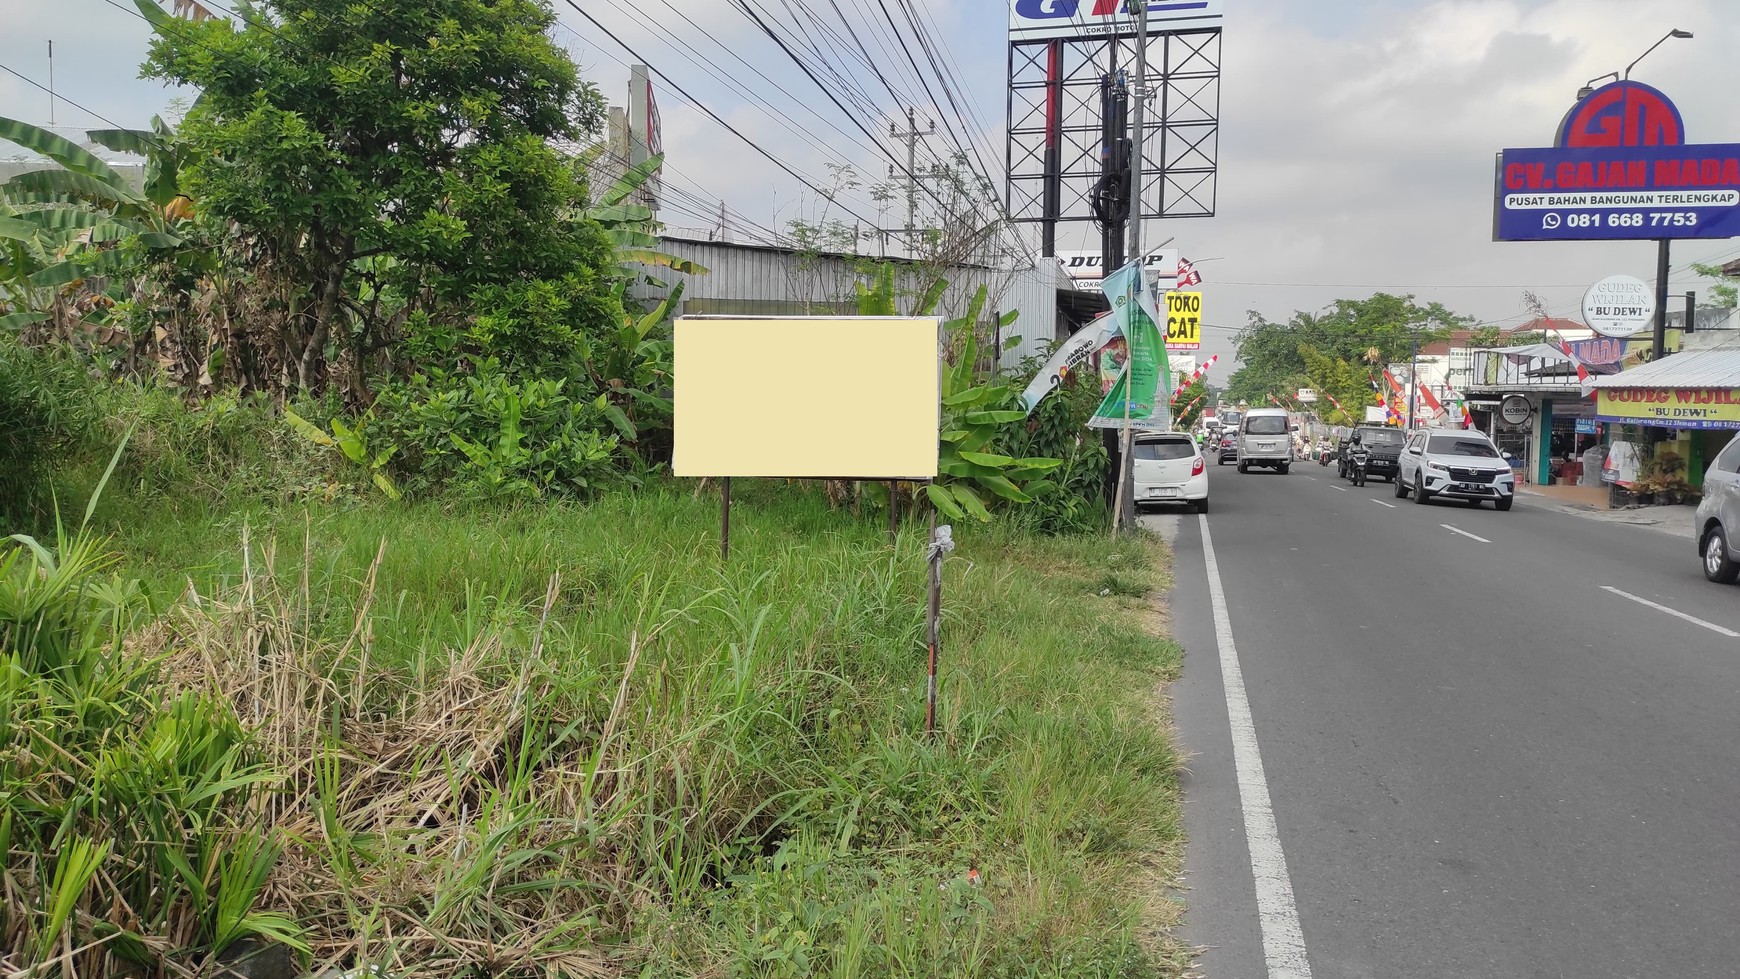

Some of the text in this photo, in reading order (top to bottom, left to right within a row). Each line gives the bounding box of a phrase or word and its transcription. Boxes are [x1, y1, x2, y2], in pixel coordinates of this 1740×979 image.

[1568, 87, 1678, 148] GM
[1655, 159, 1740, 187] MADA
[1508, 193, 1735, 206] PUSAT BAHAN BANGUNAN TERLENGKAP
[1567, 212, 1697, 227] 081 668 7753
[1597, 282, 1643, 293] GUDEG
[1167, 295, 1200, 313] TOKO
[1613, 307, 1643, 316] DEWI
[1167, 316, 1198, 339] CAT
[1606, 386, 1670, 404] GUDEG
[1673, 408, 1708, 418] DEWI
